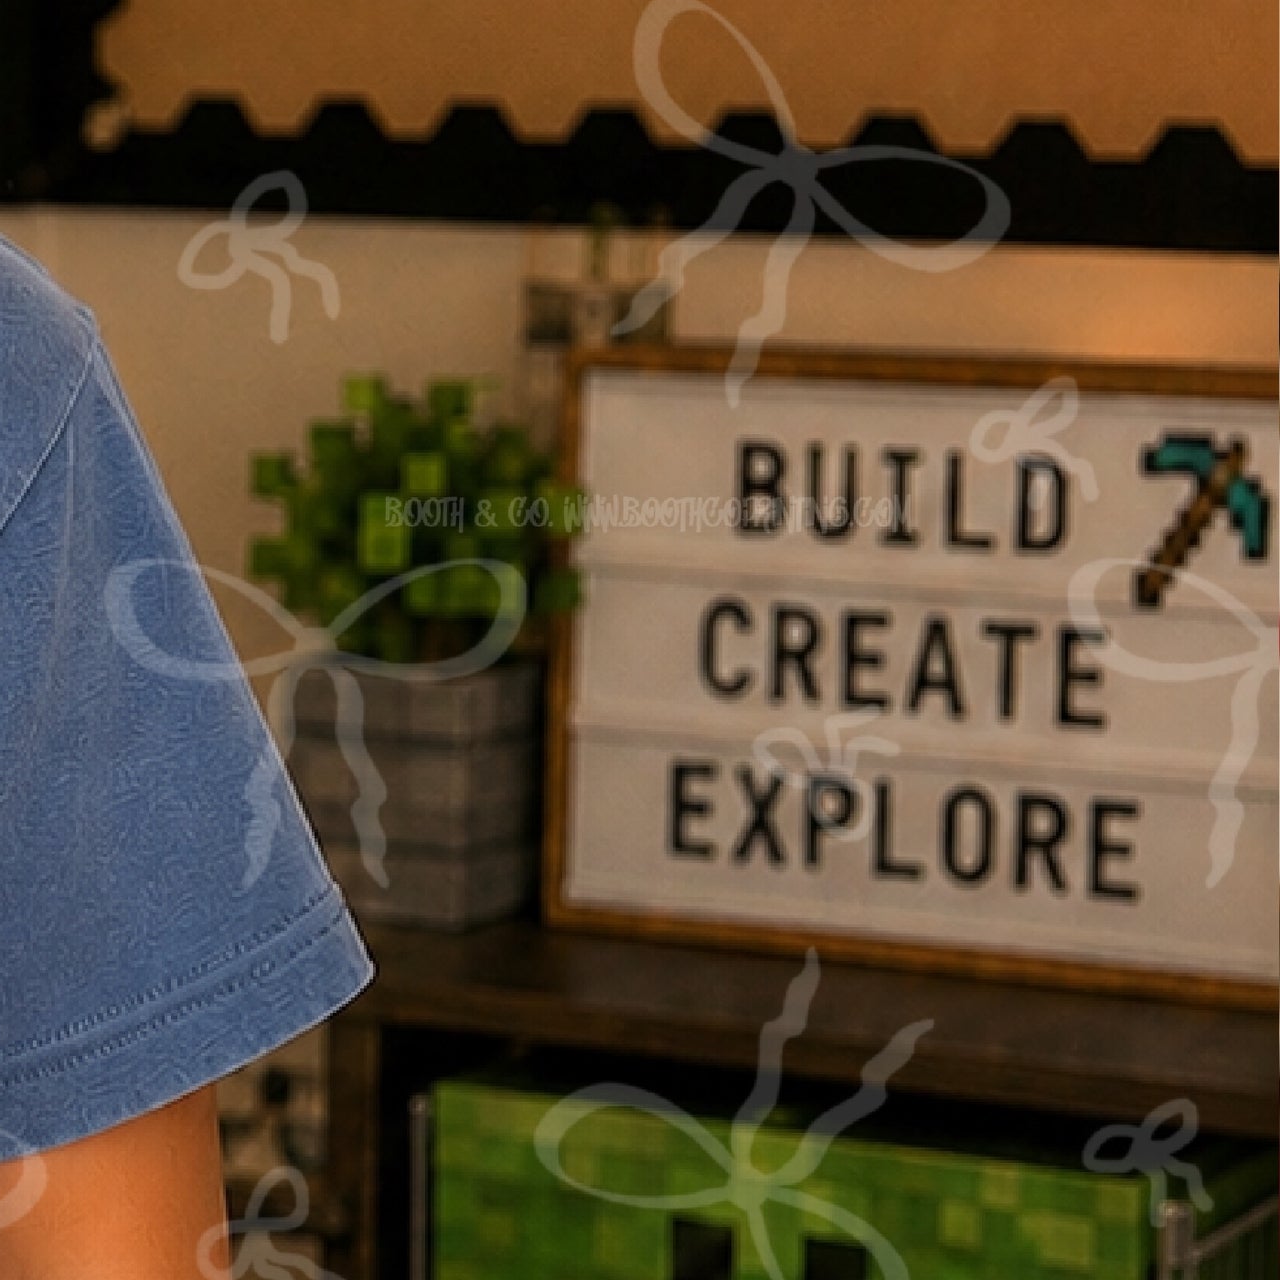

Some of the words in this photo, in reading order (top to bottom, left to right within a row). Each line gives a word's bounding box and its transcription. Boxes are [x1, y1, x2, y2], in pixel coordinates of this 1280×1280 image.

[736, 439, 1069, 554] BUILD
[700, 596, 1111, 730] CREATE
[667, 758, 1140, 904] EXPLORE
